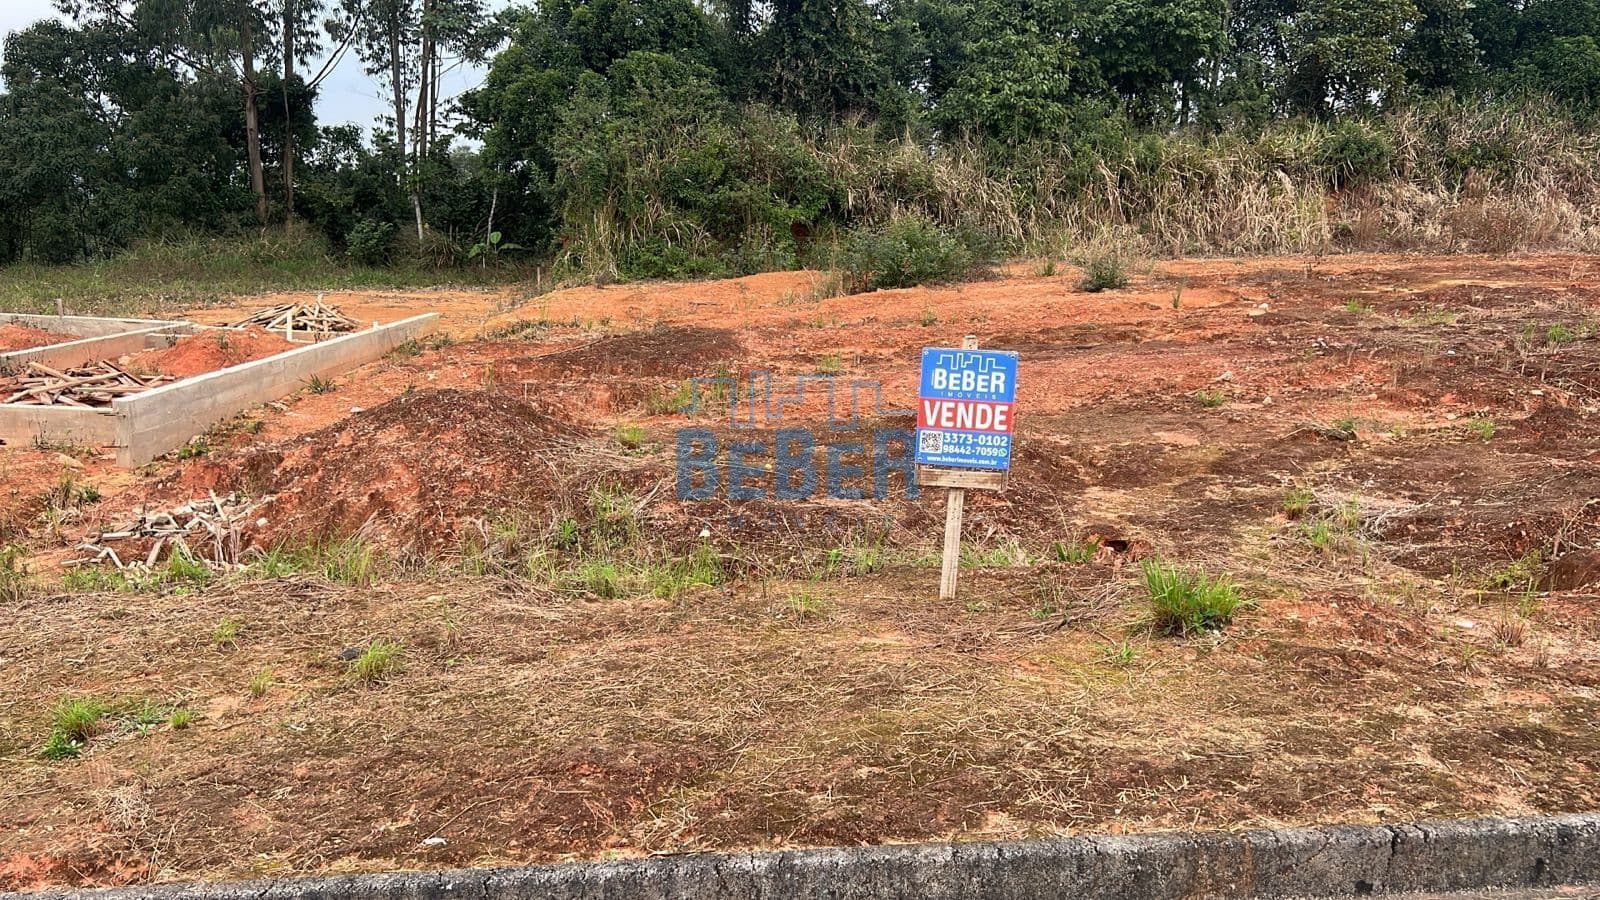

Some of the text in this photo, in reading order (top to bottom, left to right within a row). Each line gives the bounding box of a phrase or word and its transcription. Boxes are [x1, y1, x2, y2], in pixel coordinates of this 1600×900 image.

[923, 400, 1009, 431] VENDE
[944, 433, 1008, 446] 3373-0102
[943, 445, 998, 456] 98442-7059
[926, 455, 998, 466] www.beberimoveis.com.br
